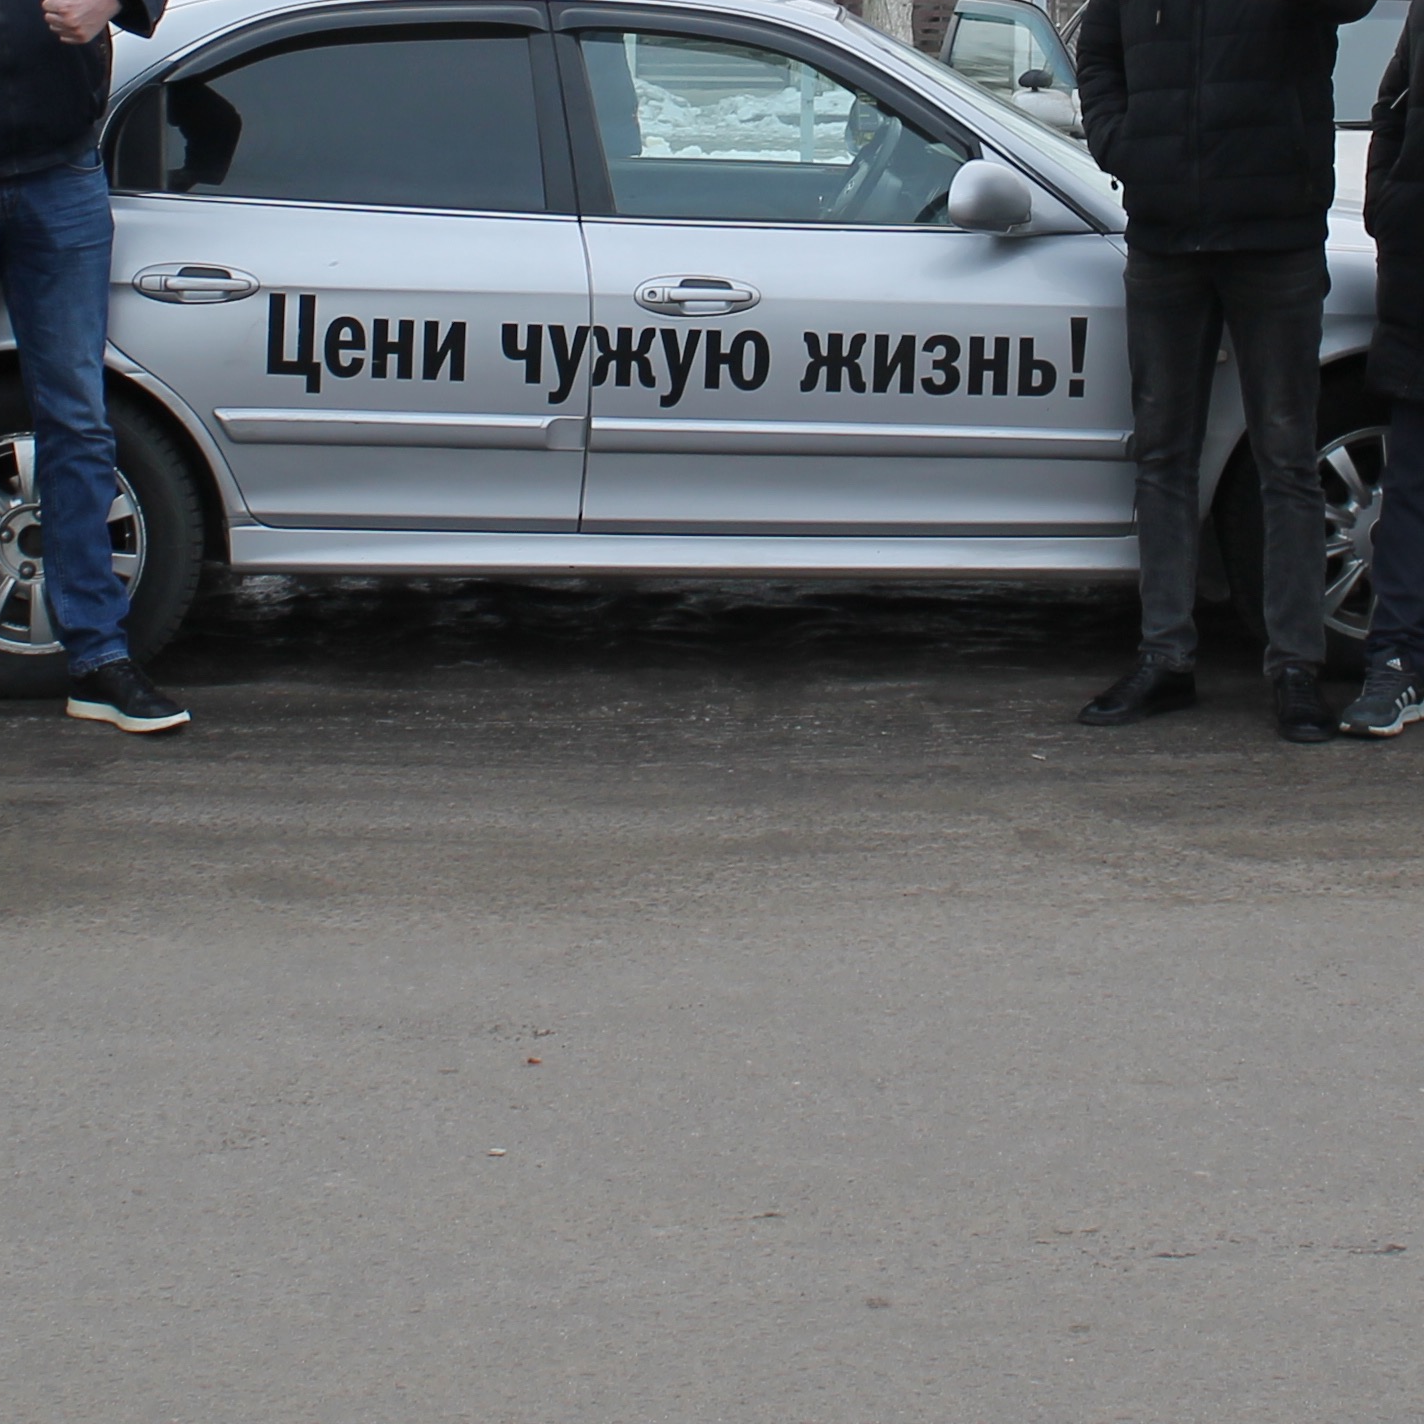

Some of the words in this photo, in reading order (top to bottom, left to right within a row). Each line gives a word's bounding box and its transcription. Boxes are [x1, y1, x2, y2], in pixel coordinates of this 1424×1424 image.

[266, 292, 467, 394] Цени
[501, 322, 771, 408] чужую
[799, 316, 1089, 399] жизнь!
